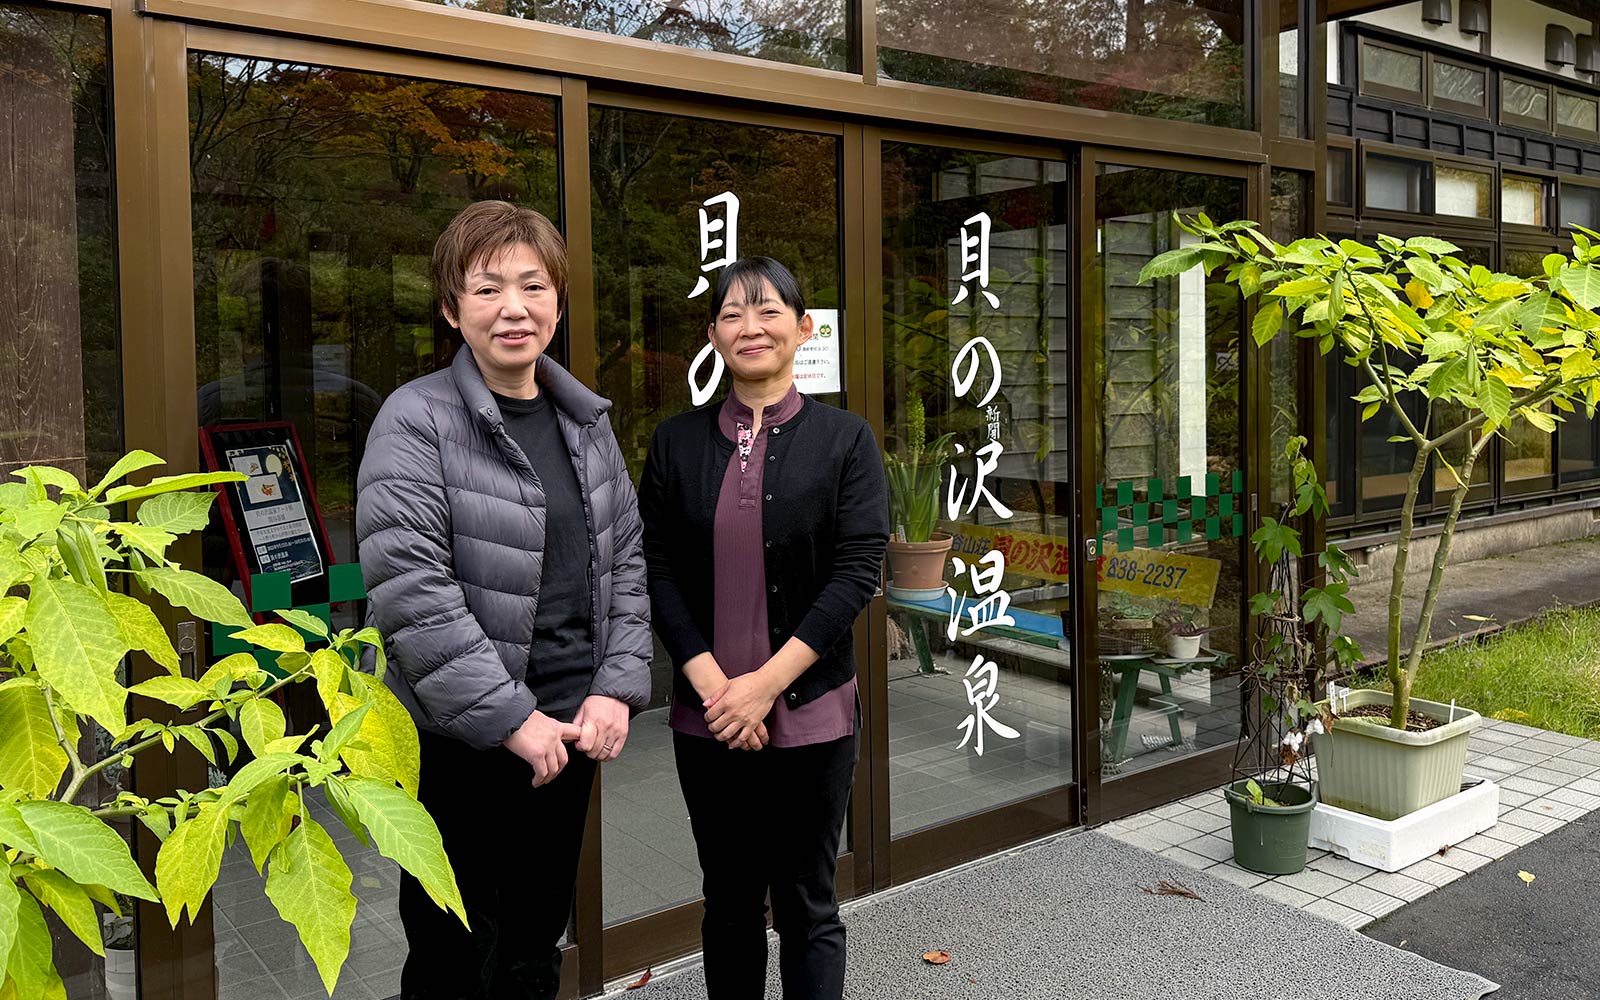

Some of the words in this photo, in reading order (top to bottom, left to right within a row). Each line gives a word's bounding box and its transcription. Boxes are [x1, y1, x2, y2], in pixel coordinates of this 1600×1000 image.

[946, 211, 1021, 756] 貝の沢温泉
